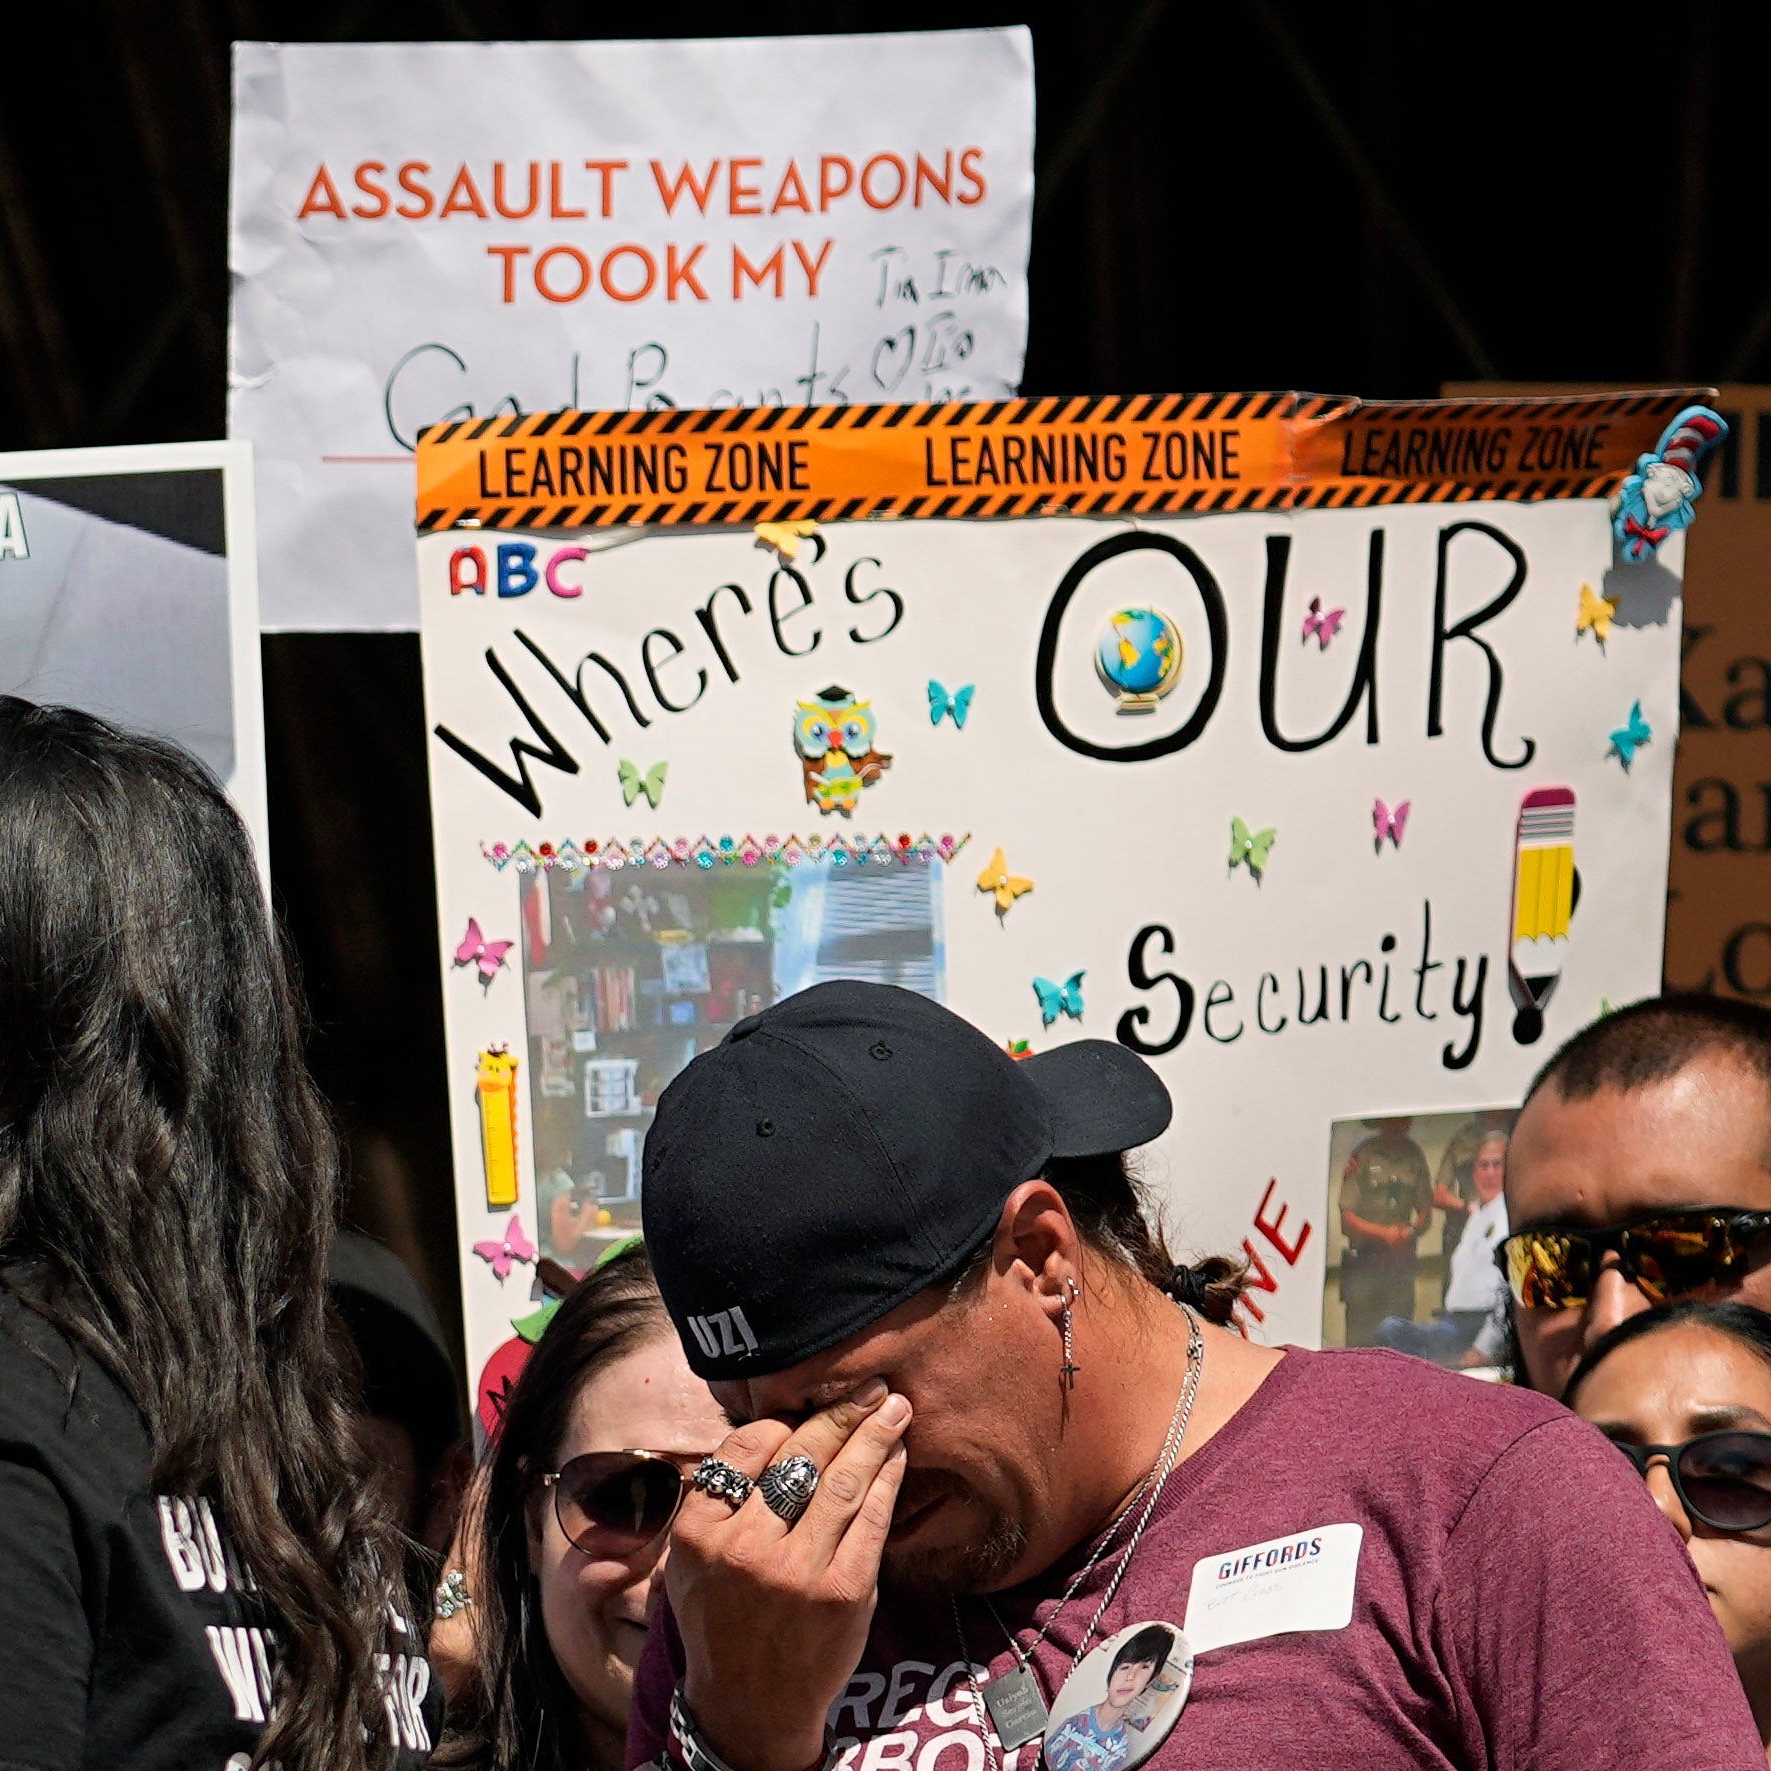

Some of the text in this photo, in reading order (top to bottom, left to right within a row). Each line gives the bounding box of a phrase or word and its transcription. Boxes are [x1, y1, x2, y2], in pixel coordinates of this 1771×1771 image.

[298, 146, 987, 220] ASSAULT WEAPONS
[487, 240, 833, 304] TOOK MY
[478, 440, 810, 500] LEARNING ZONE
[925, 429, 1240, 488] LEARNING ZONE
[1340, 422, 1613, 477] LEARNING ZONE
[434, 527, 905, 820] Where's
[1035, 521, 1535, 769] OUR
[1115, 899, 1490, 1071] Security
[1218, 1537, 1322, 1580] GIFFORDS
[827, 1660, 990, 1728] REG
